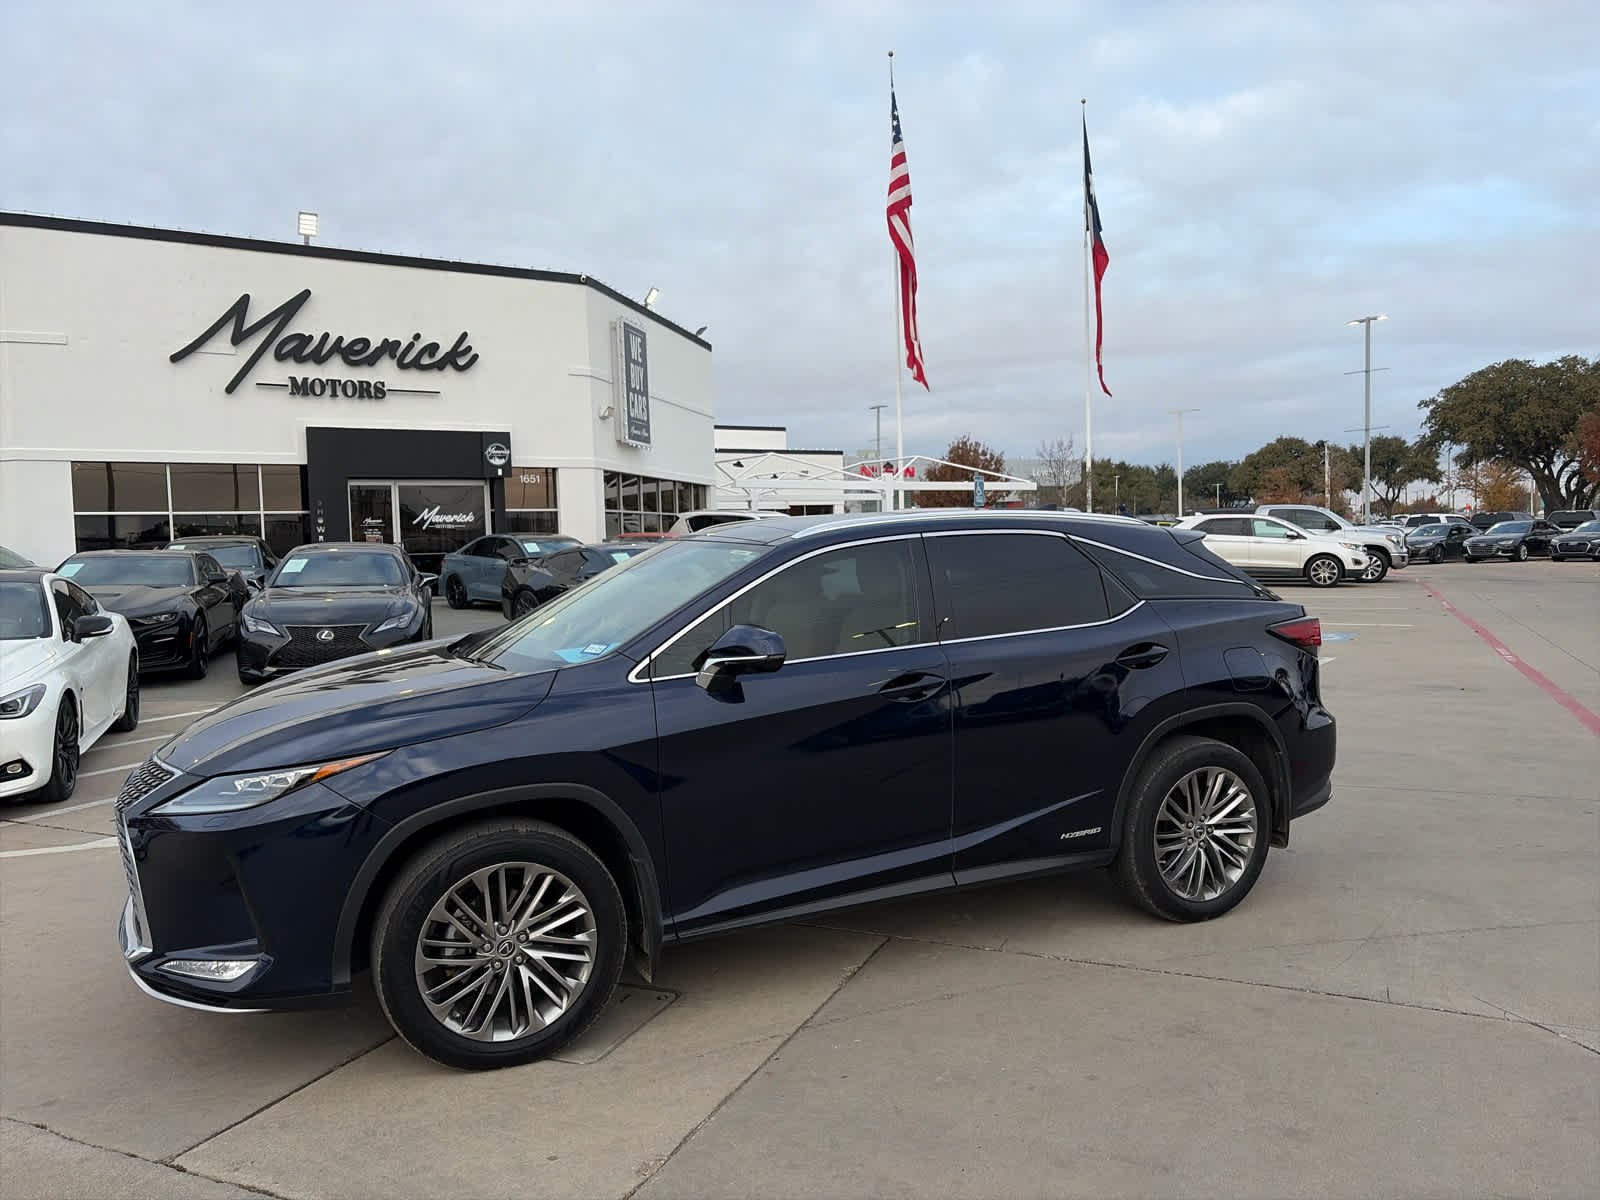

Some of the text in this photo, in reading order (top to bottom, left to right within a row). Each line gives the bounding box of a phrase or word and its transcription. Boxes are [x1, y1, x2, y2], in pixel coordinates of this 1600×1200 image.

[169, 288, 479, 394] Maverick
[629, 334, 642, 363] WE
[288, 376, 387, 400] MOTORS
[630, 362, 644, 391] BUY
[629, 391, 648, 421] CARS
[520, 474, 540, 484] 1651
[860, 465, 915, 478] NISN
[412, 505, 475, 530] Maverick
[1060, 827, 1102, 840] HYBRID
